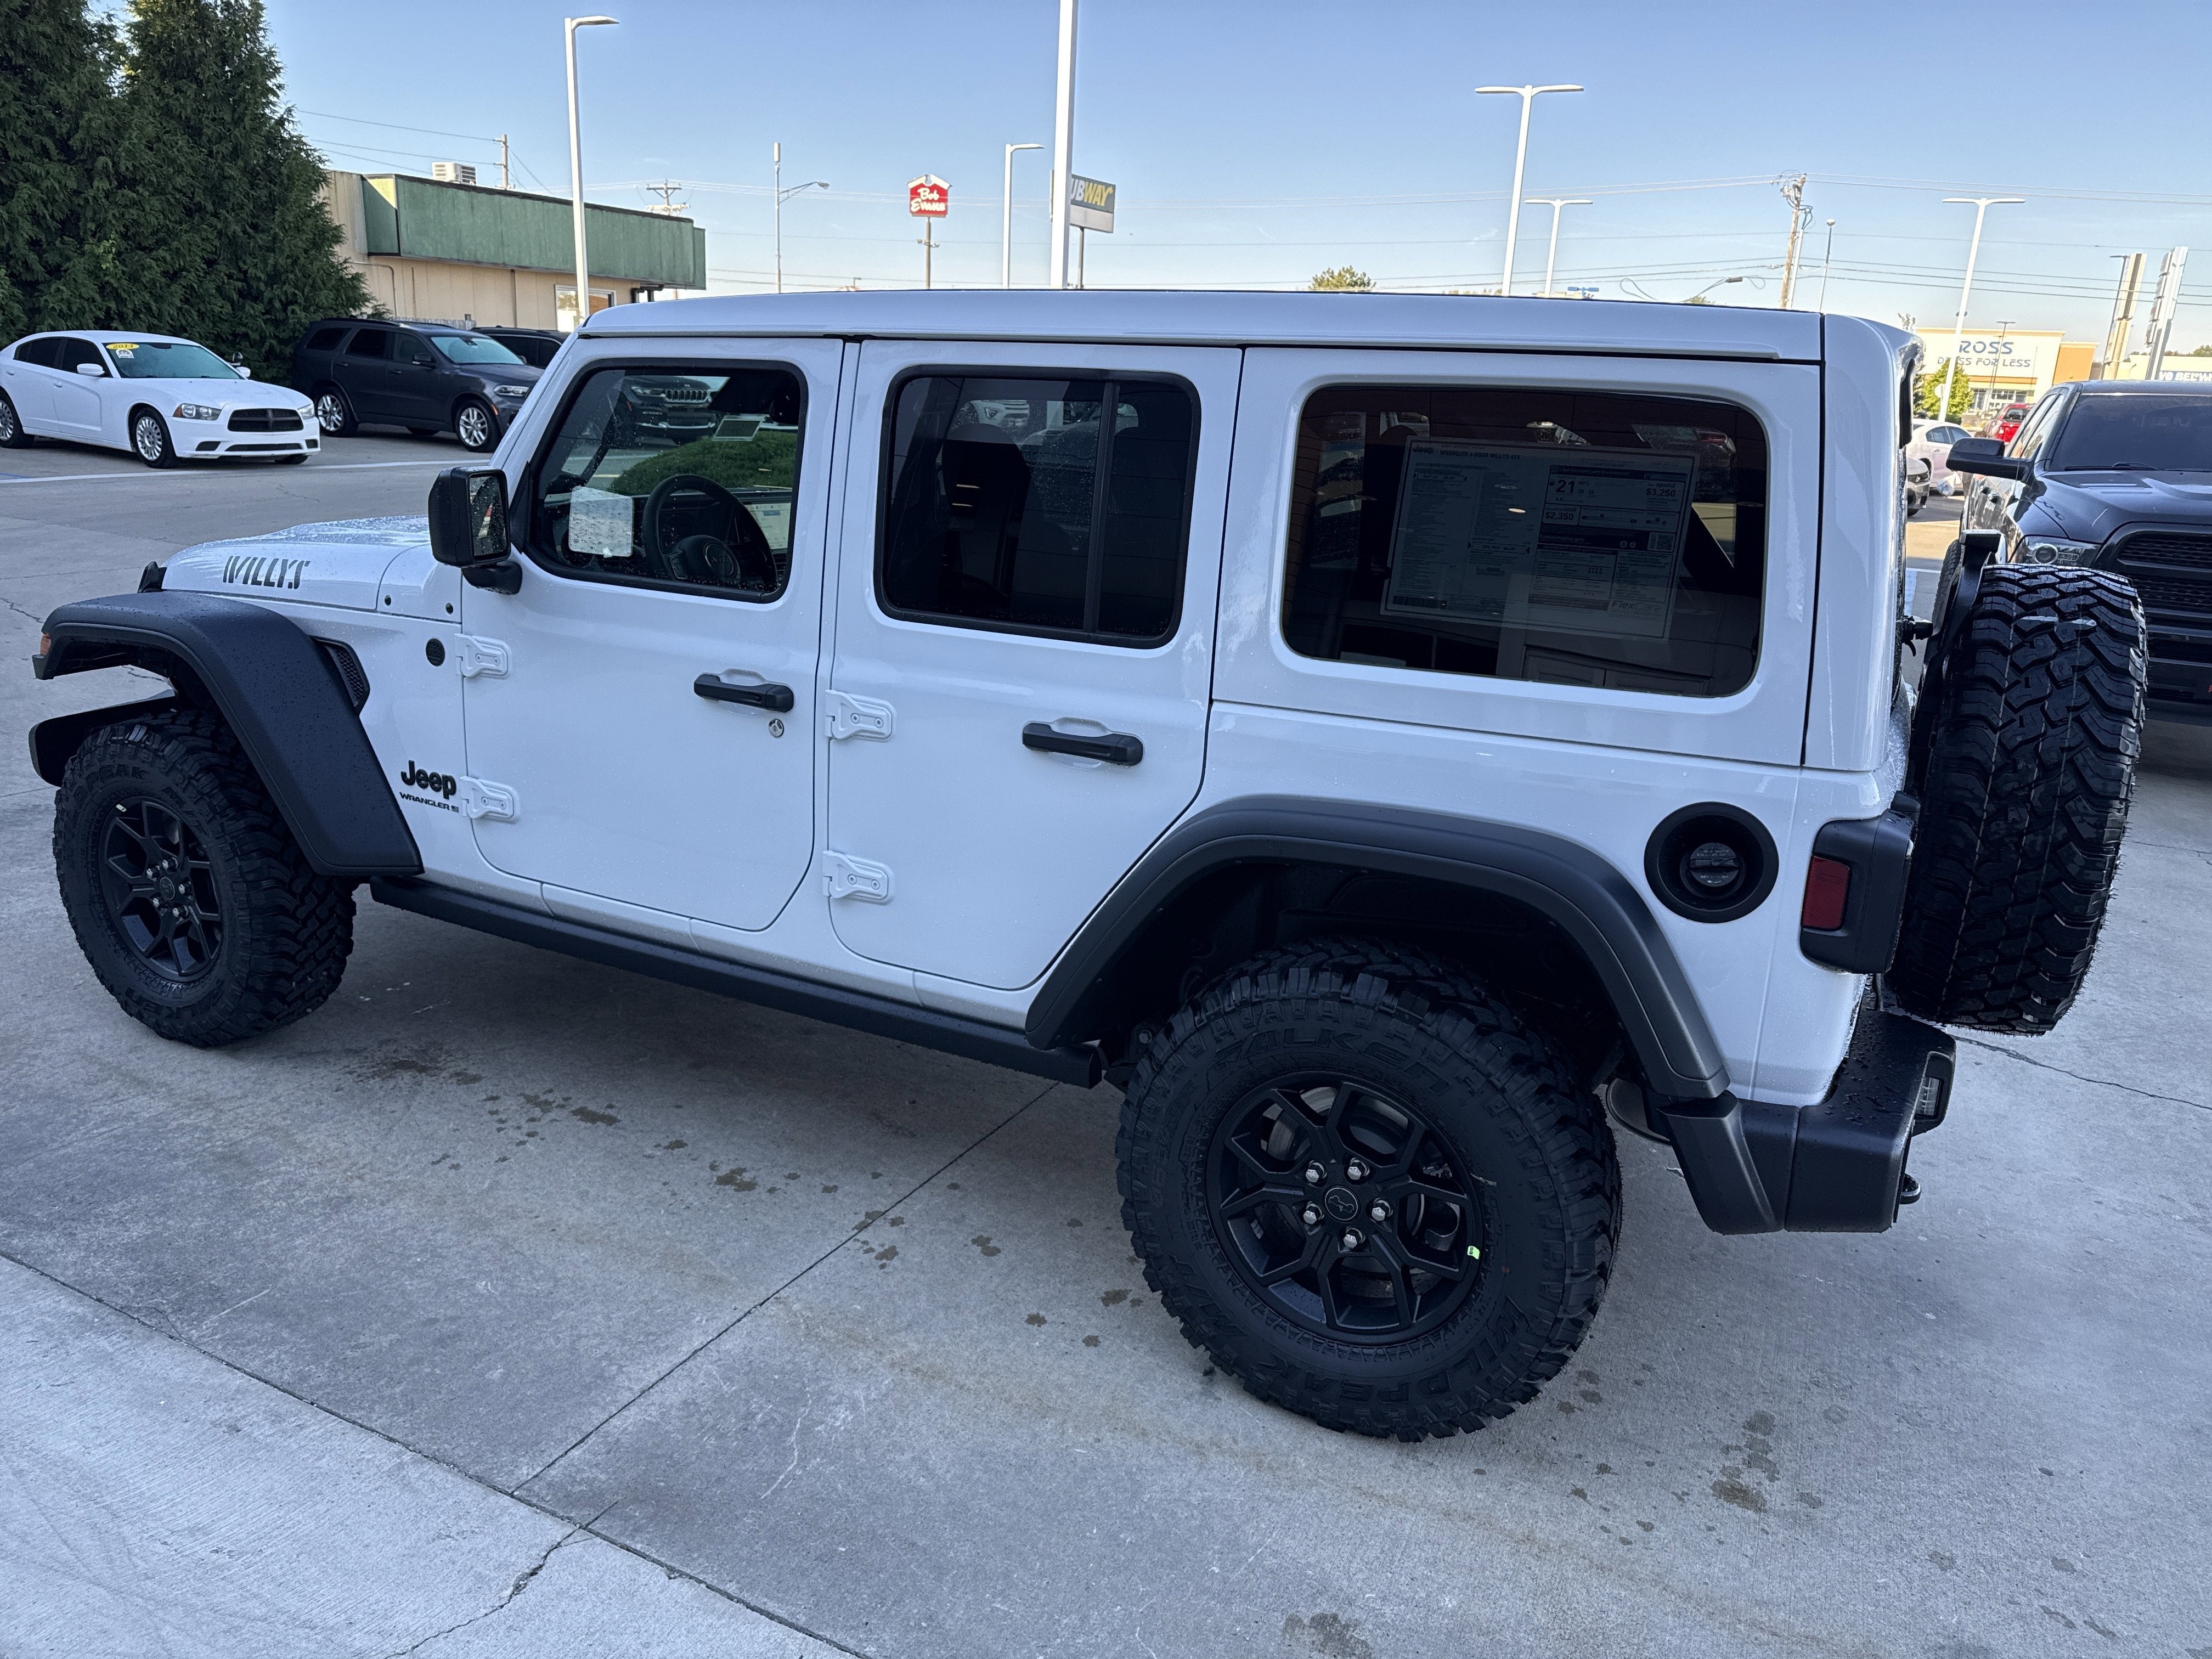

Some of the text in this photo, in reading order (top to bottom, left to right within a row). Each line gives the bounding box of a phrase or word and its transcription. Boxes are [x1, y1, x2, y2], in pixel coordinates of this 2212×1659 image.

[917, 188, 940, 200] Bob
[1071, 178, 1114, 206] UBWAY
[911, 198, 946, 212] Evans
[1959, 341, 2015, 354] ROSS
[1937, 357, 2031, 367] DSS FOR LESS
[1556, 479, 1575, 493] 21
[1646, 488, 1676, 497] $3,250
[1545, 511, 1574, 521] $2,350
[223, 555, 311, 589] WILLYS
[1612, 600, 1662, 612] FlexCare
[400, 760, 456, 800] Jeep
[399, 792, 450, 811] WRANGLER
[1214, 1028, 1452, 1093] FALKEN
[1257, 1295, 1526, 1403] WILDPEAK
